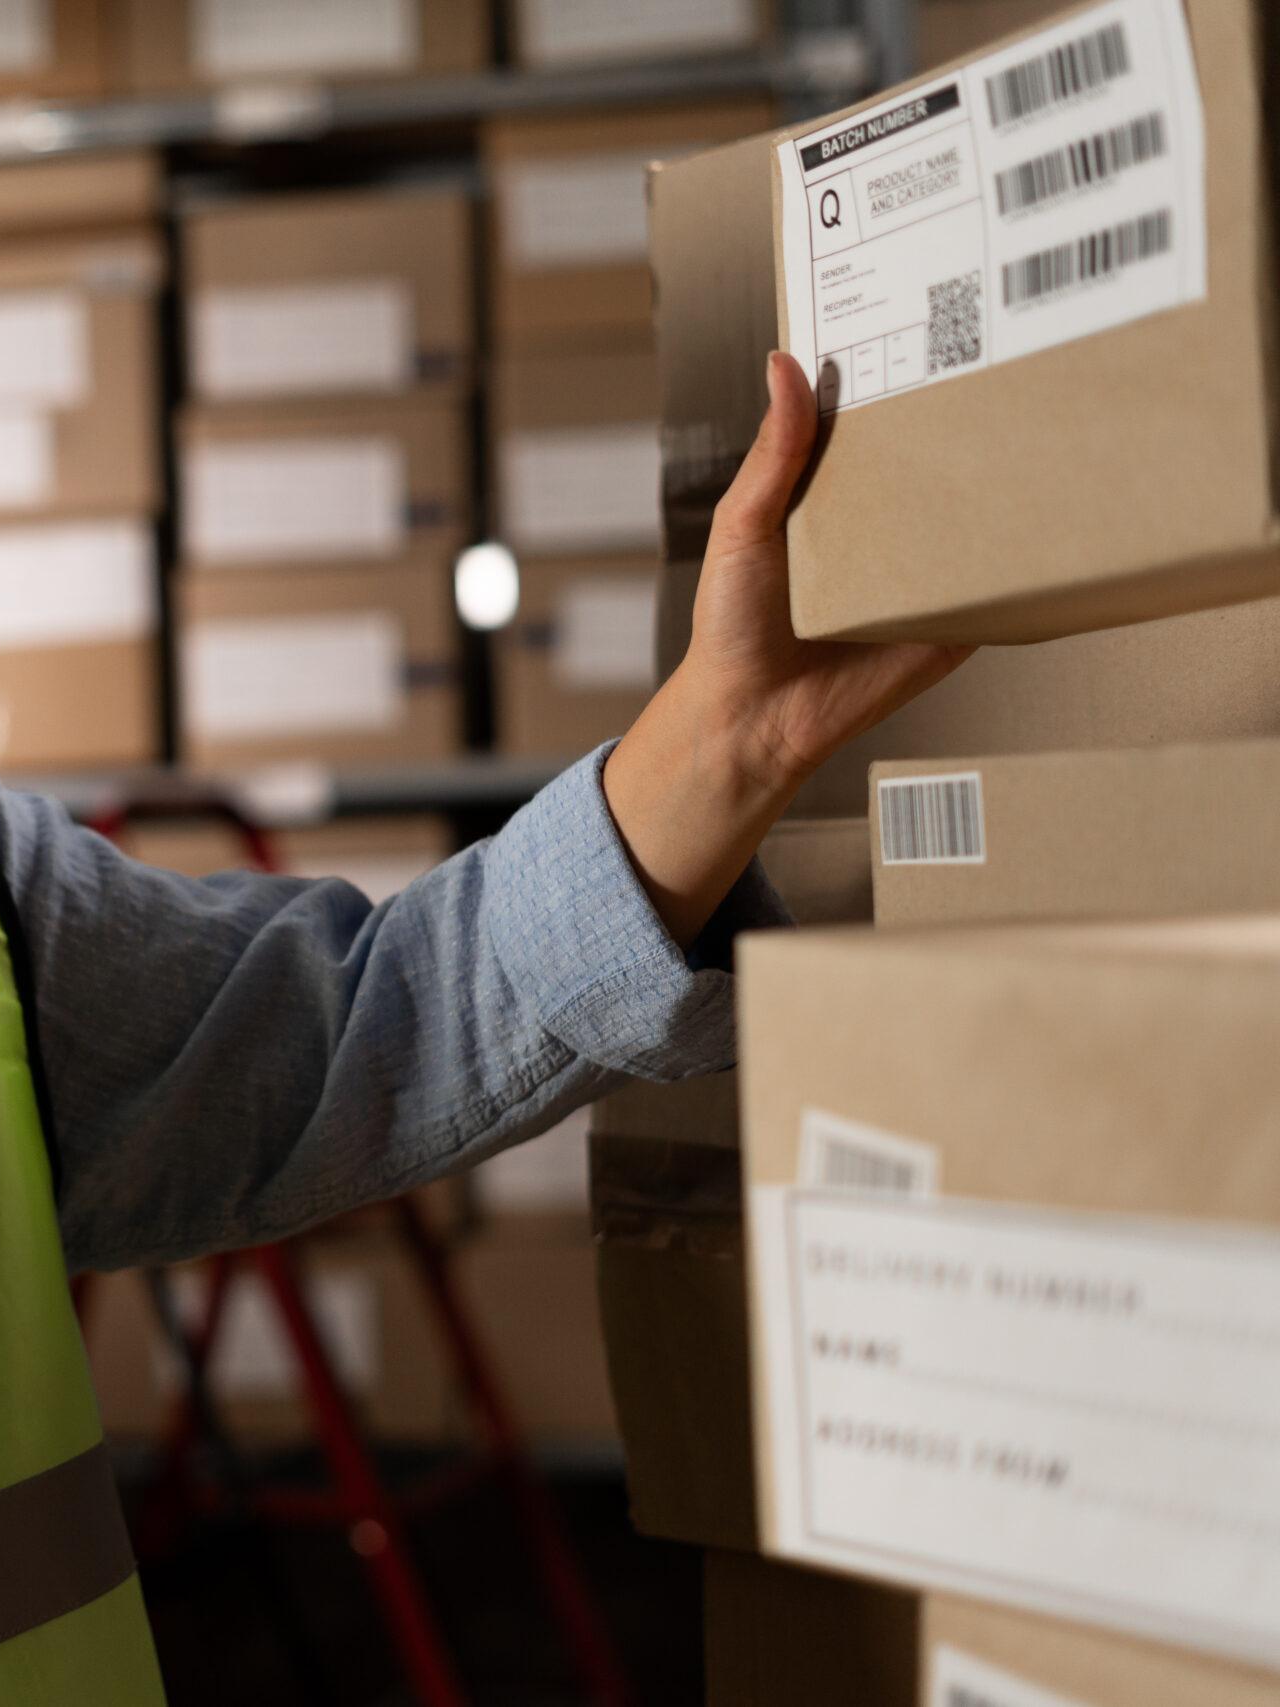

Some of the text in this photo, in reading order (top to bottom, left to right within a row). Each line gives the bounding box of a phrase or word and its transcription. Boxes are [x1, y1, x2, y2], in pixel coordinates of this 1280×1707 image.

[821, 98, 928, 159] BATCH NUMBER
[867, 147, 960, 194] PRODUCT NAME
[871, 169, 960, 215] AND CATEGORY
[820, 188, 842, 229] Q
[985, 1261, 1144, 1317] NUMBER
[811, 1330, 903, 1369] NAME
[972, 1437, 1072, 1488] FROM
